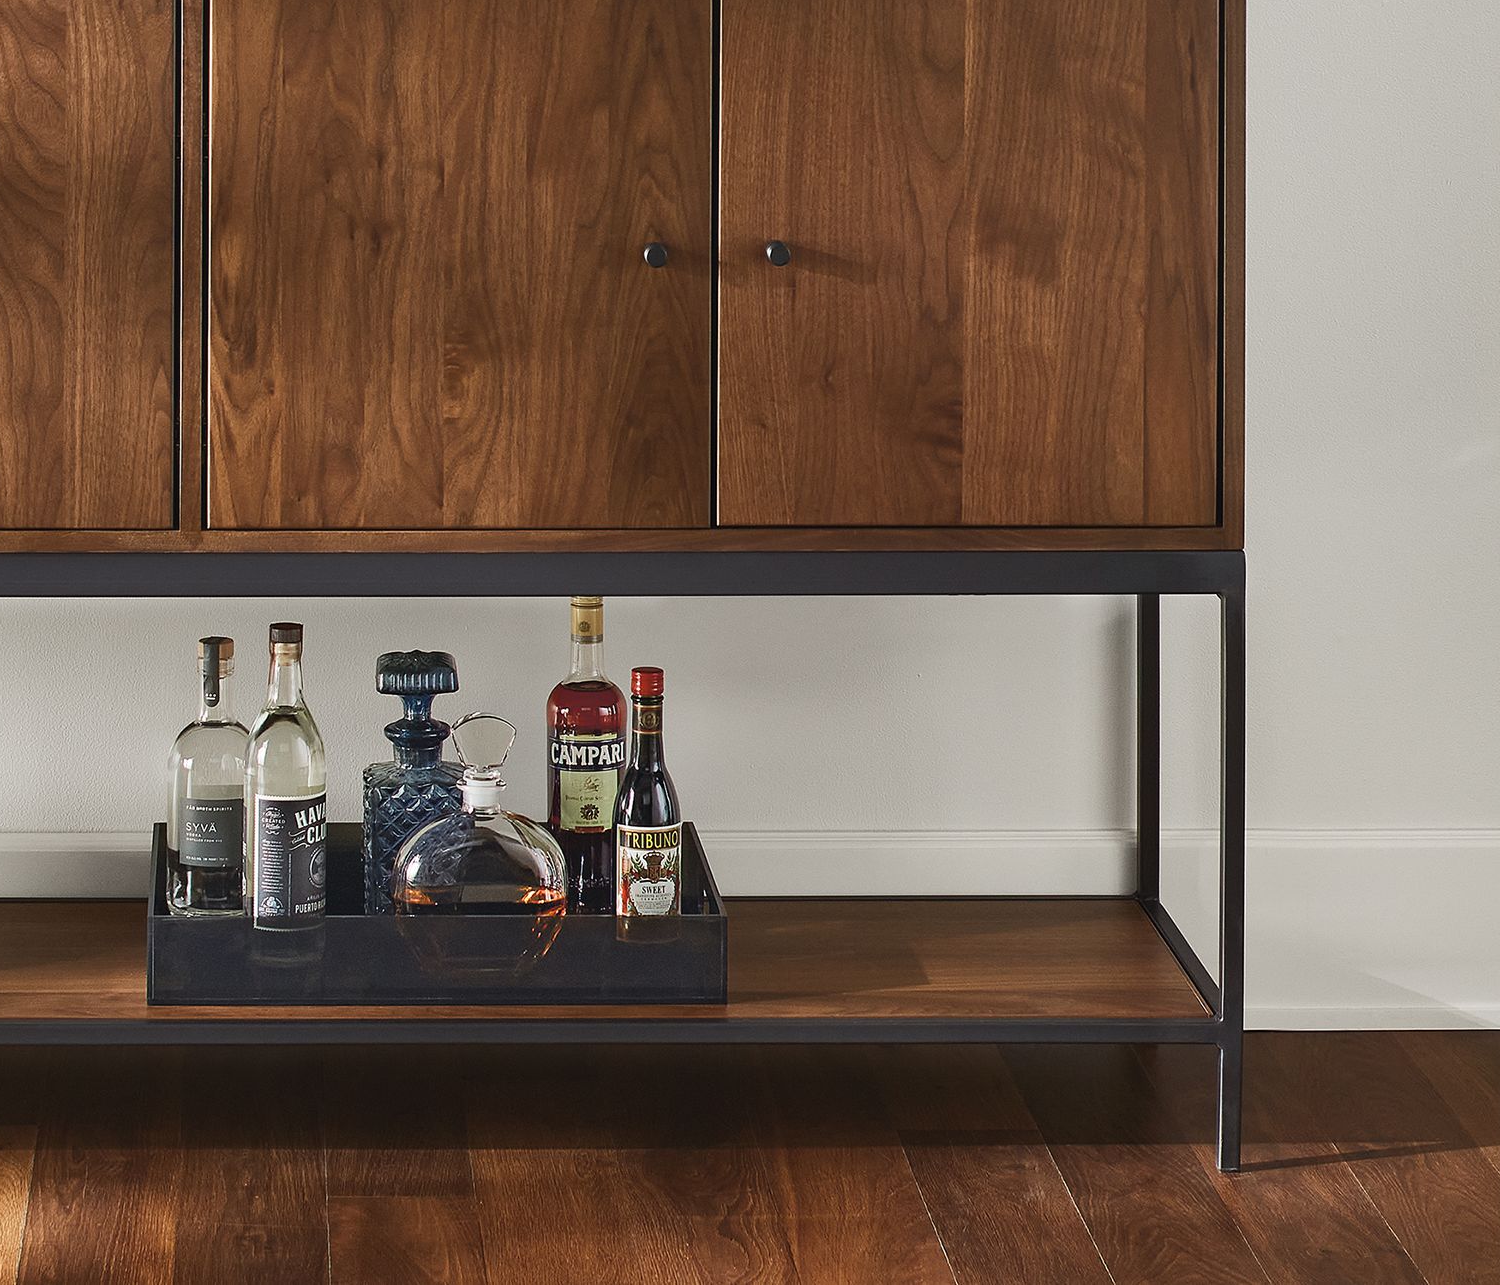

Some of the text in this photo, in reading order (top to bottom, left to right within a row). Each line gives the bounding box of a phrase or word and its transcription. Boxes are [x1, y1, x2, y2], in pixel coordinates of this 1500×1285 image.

[551, 741, 625, 766] CAMPARI
[185, 821, 217, 833] SYVÄ
[625, 830, 679, 849] TRIBUNO
[641, 885, 666, 894] SWEET
